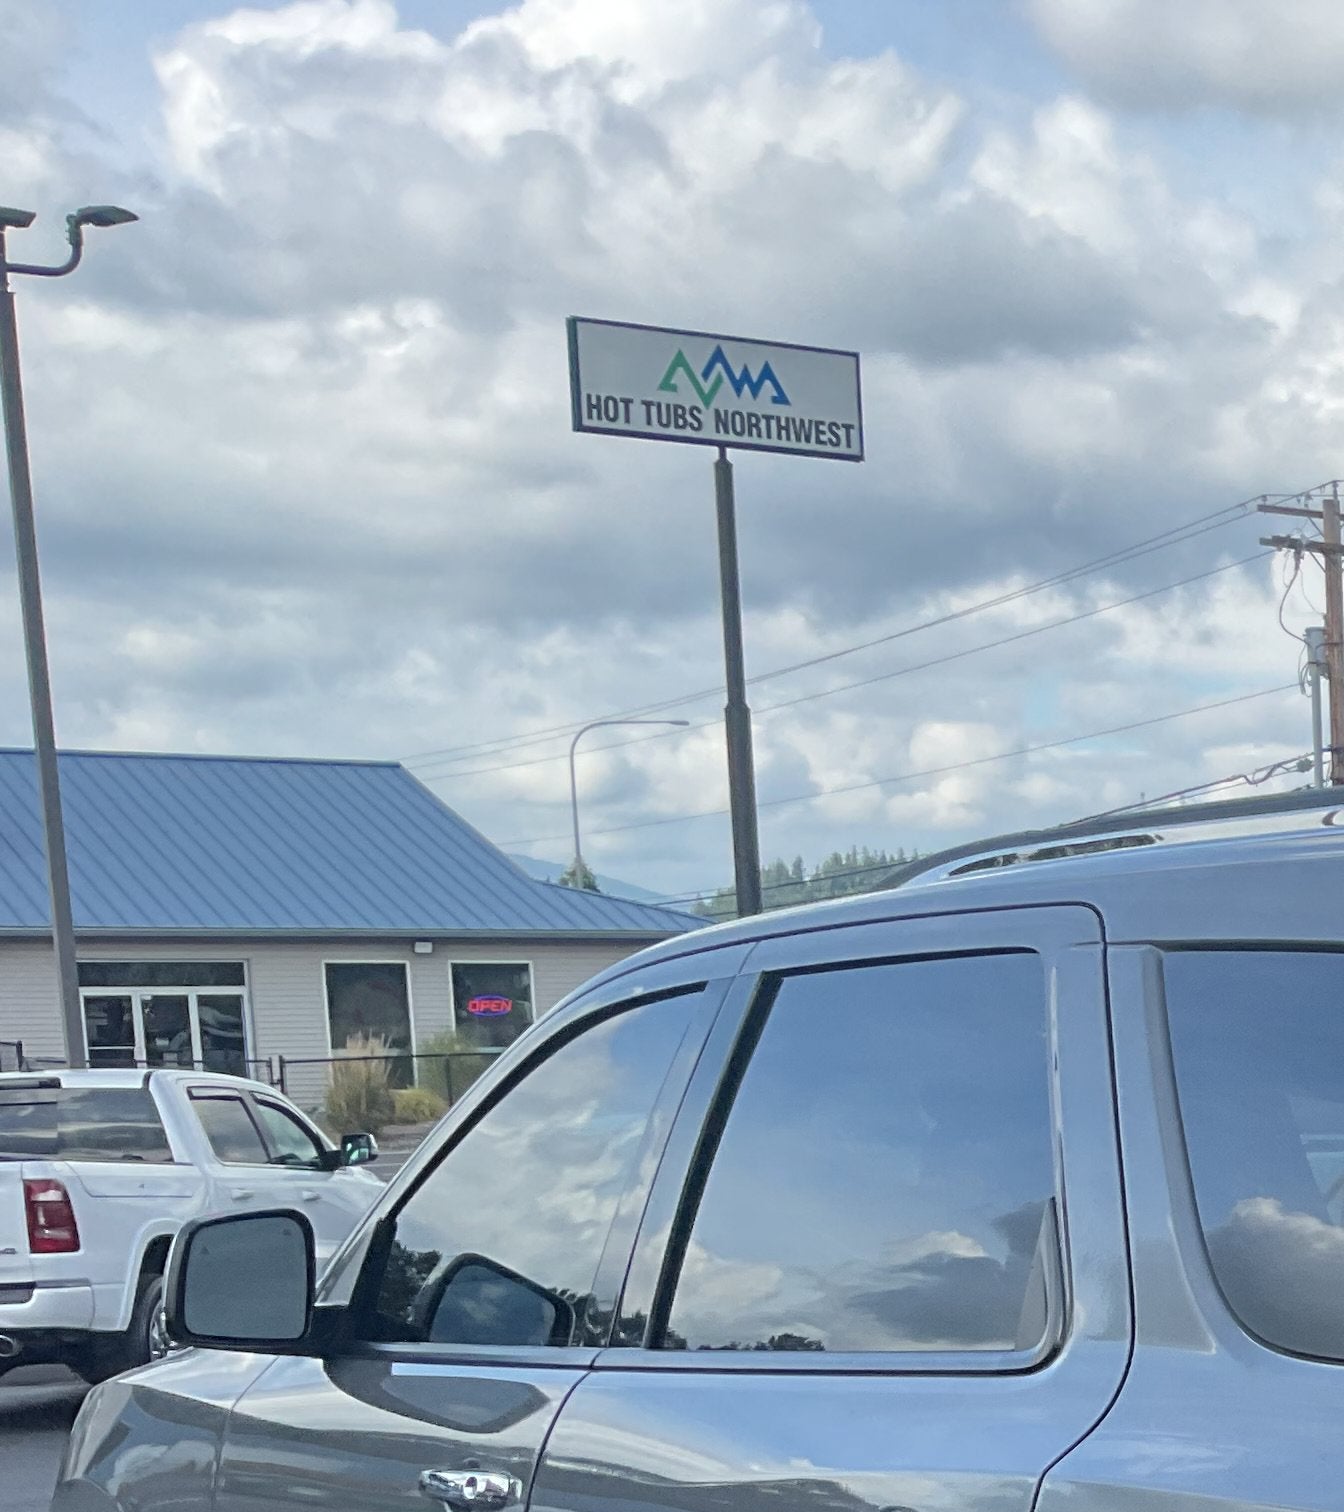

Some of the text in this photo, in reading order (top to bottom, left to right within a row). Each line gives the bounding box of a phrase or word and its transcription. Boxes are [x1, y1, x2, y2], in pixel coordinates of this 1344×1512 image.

[586, 393, 855, 449] HOT TUBS NORTHWEST
[467, 999, 513, 1013] OPEN
